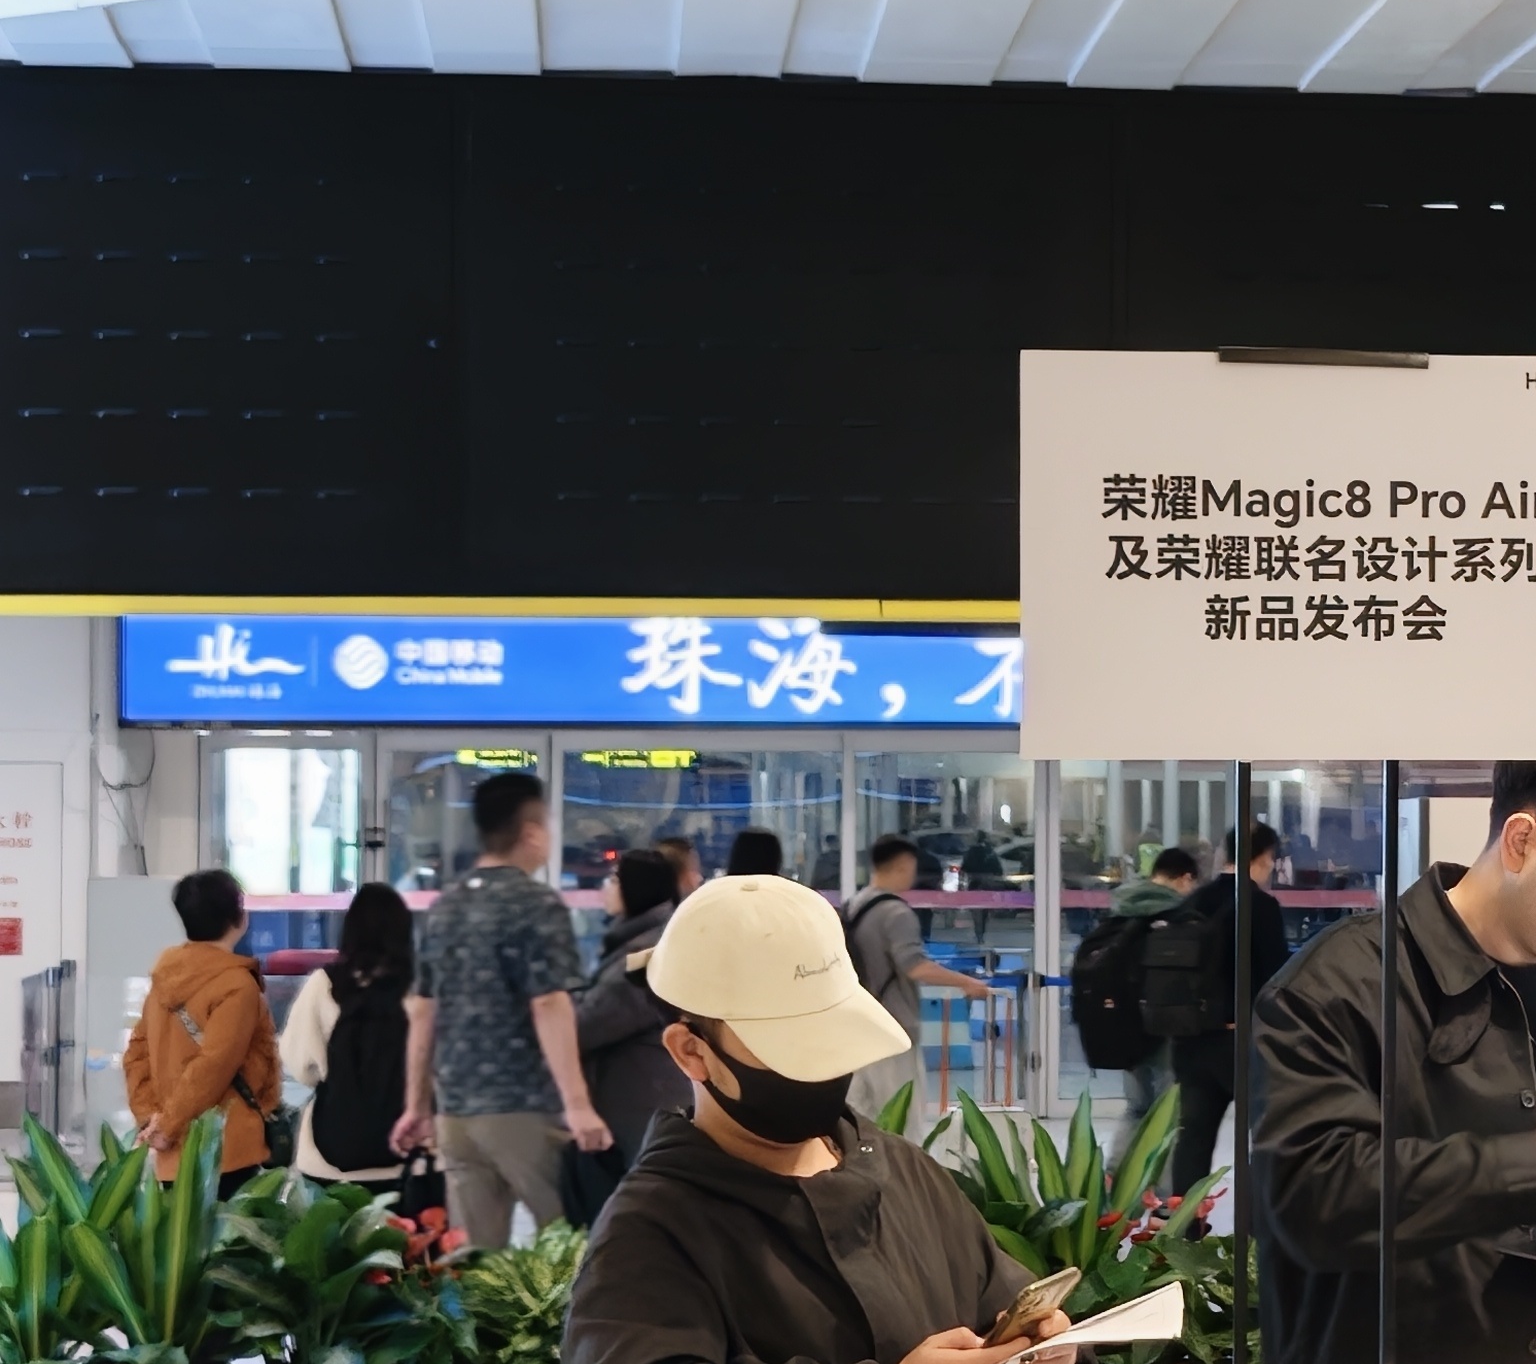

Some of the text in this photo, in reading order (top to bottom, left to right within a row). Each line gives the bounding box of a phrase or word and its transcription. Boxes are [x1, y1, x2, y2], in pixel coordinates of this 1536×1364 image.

[1101, 473, 1372, 528] 荣耀Magic8
[1389, 480, 1467, 519] Pro
[1204, 593, 1448, 642] 新品发布会
